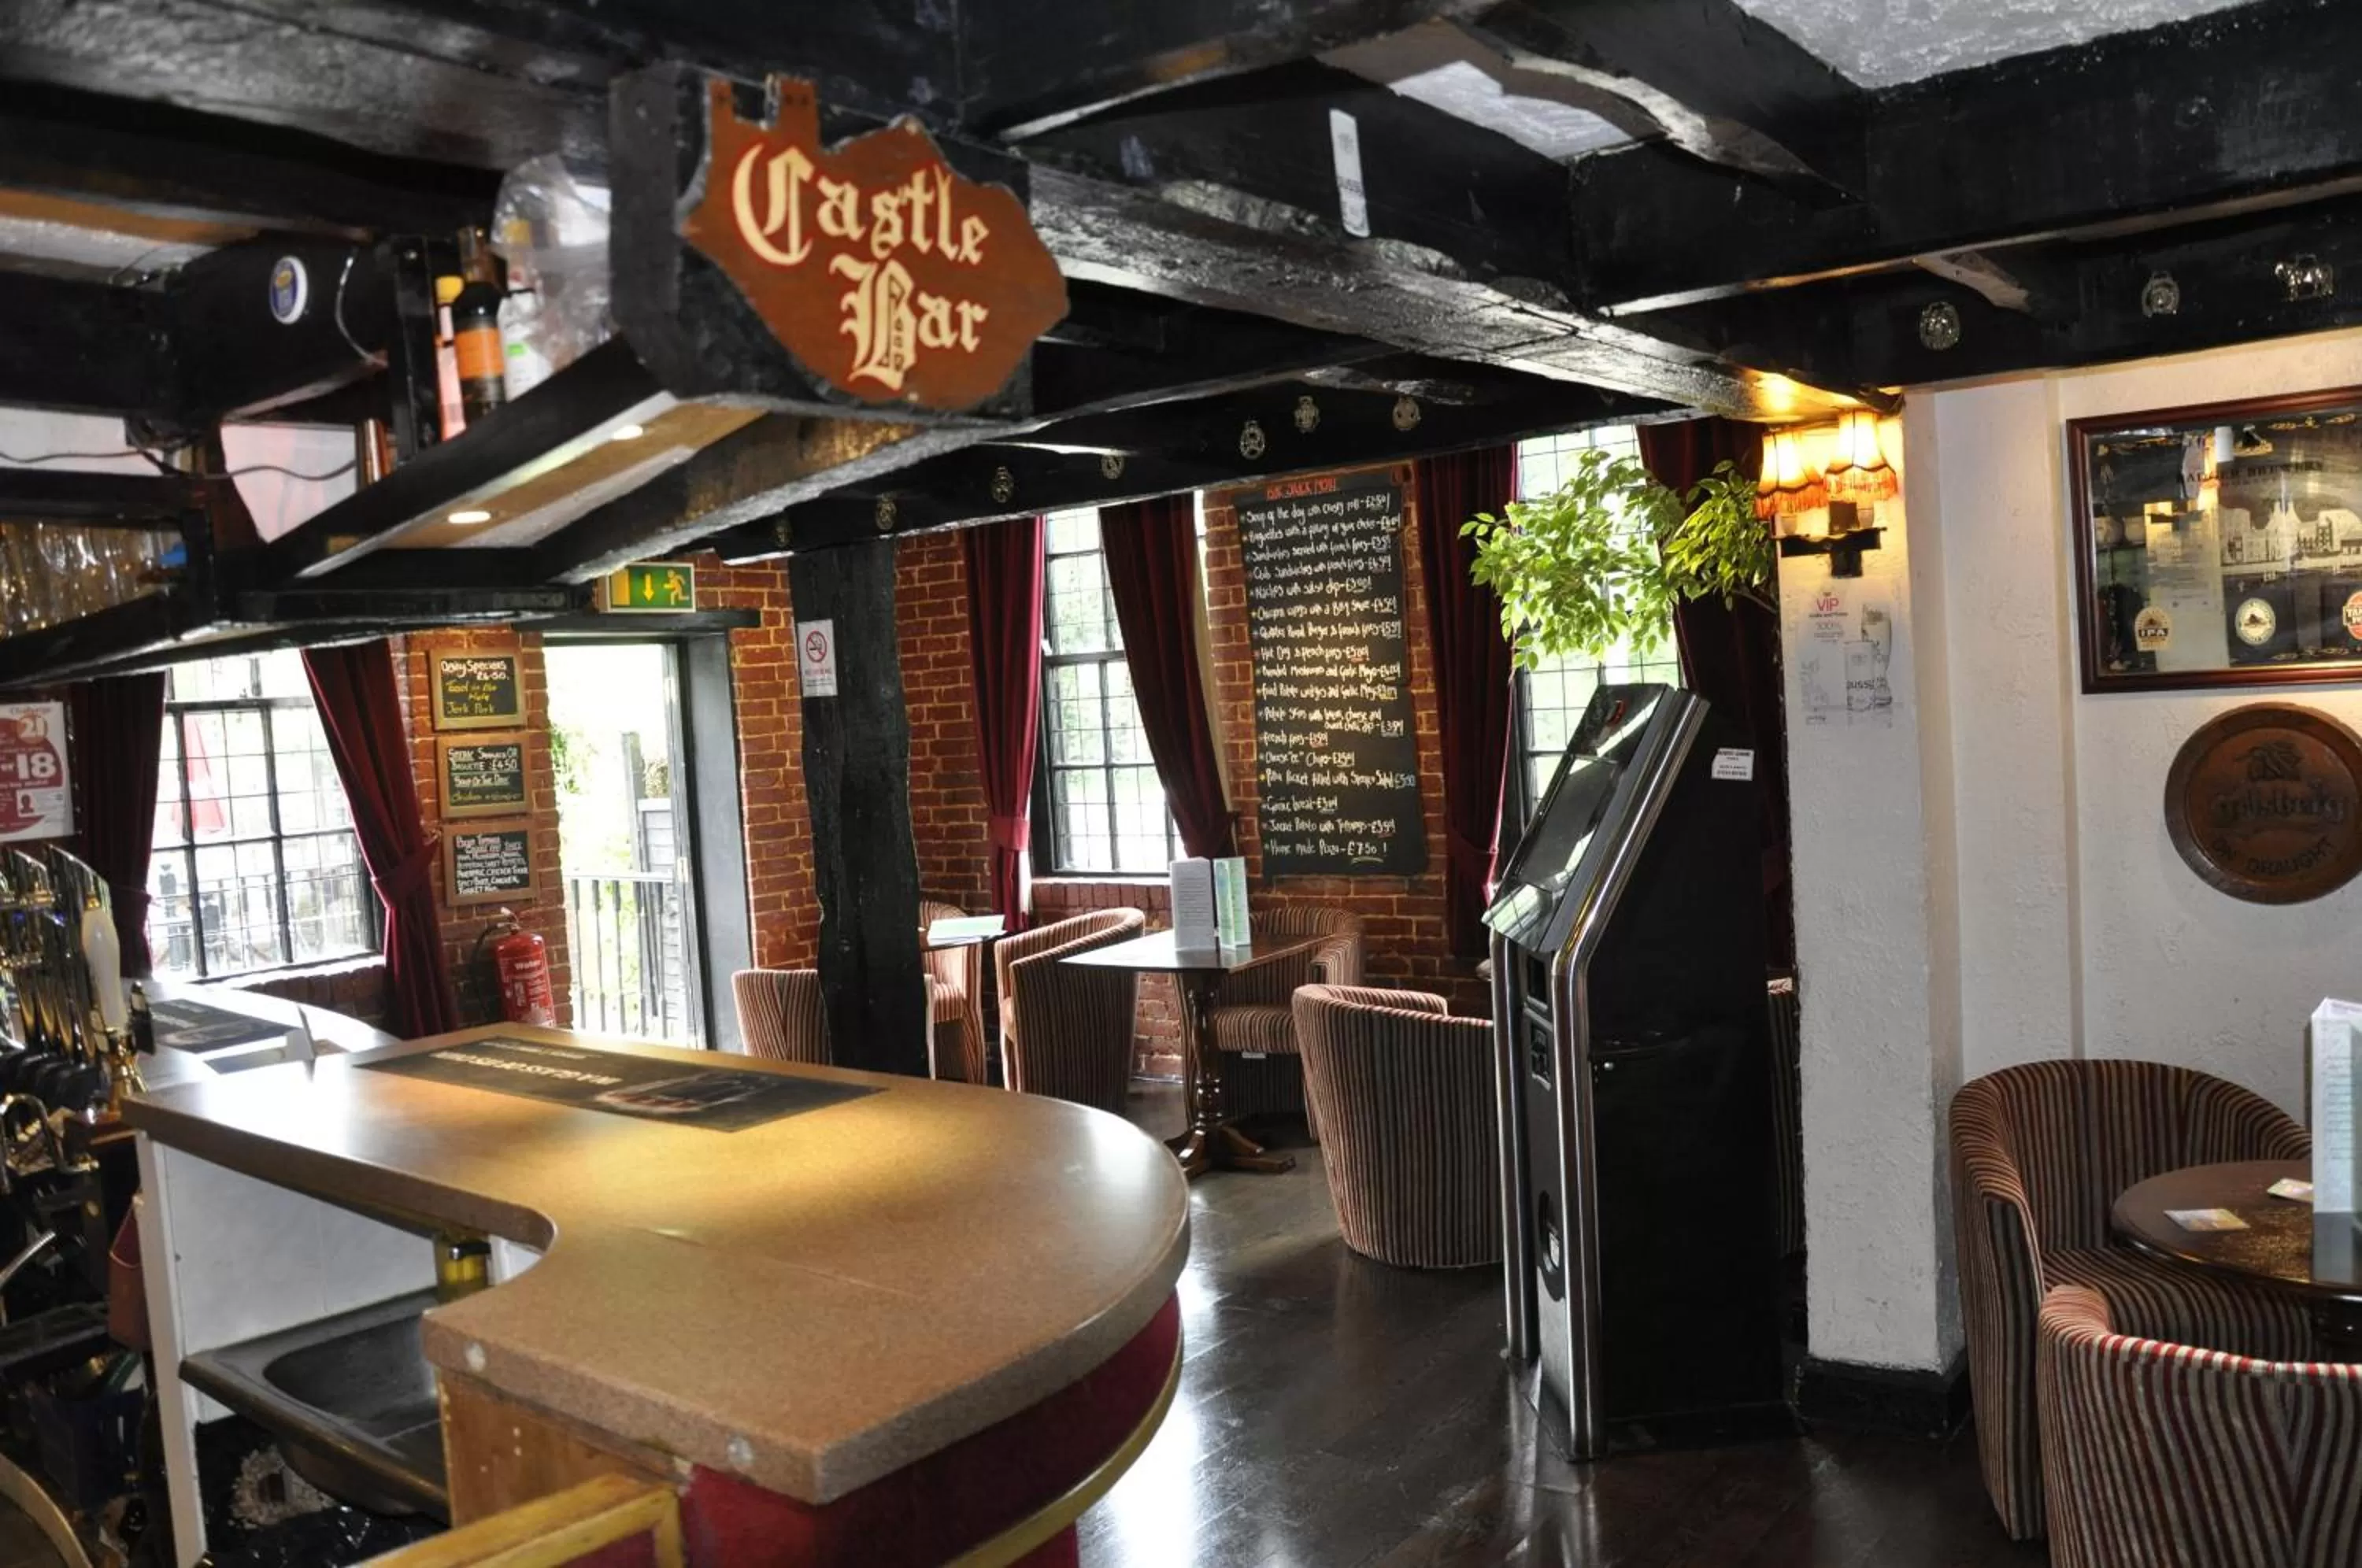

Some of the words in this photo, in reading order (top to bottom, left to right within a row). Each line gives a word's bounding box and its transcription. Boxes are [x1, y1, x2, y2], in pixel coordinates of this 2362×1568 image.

[732, 143, 989, 266] Castle
[829, 253, 988, 391] Bar
[1816, 597, 1840, 612] VIP
[2138, 629, 2168, 638] IPA
[17, 752, 57, 779] 18
